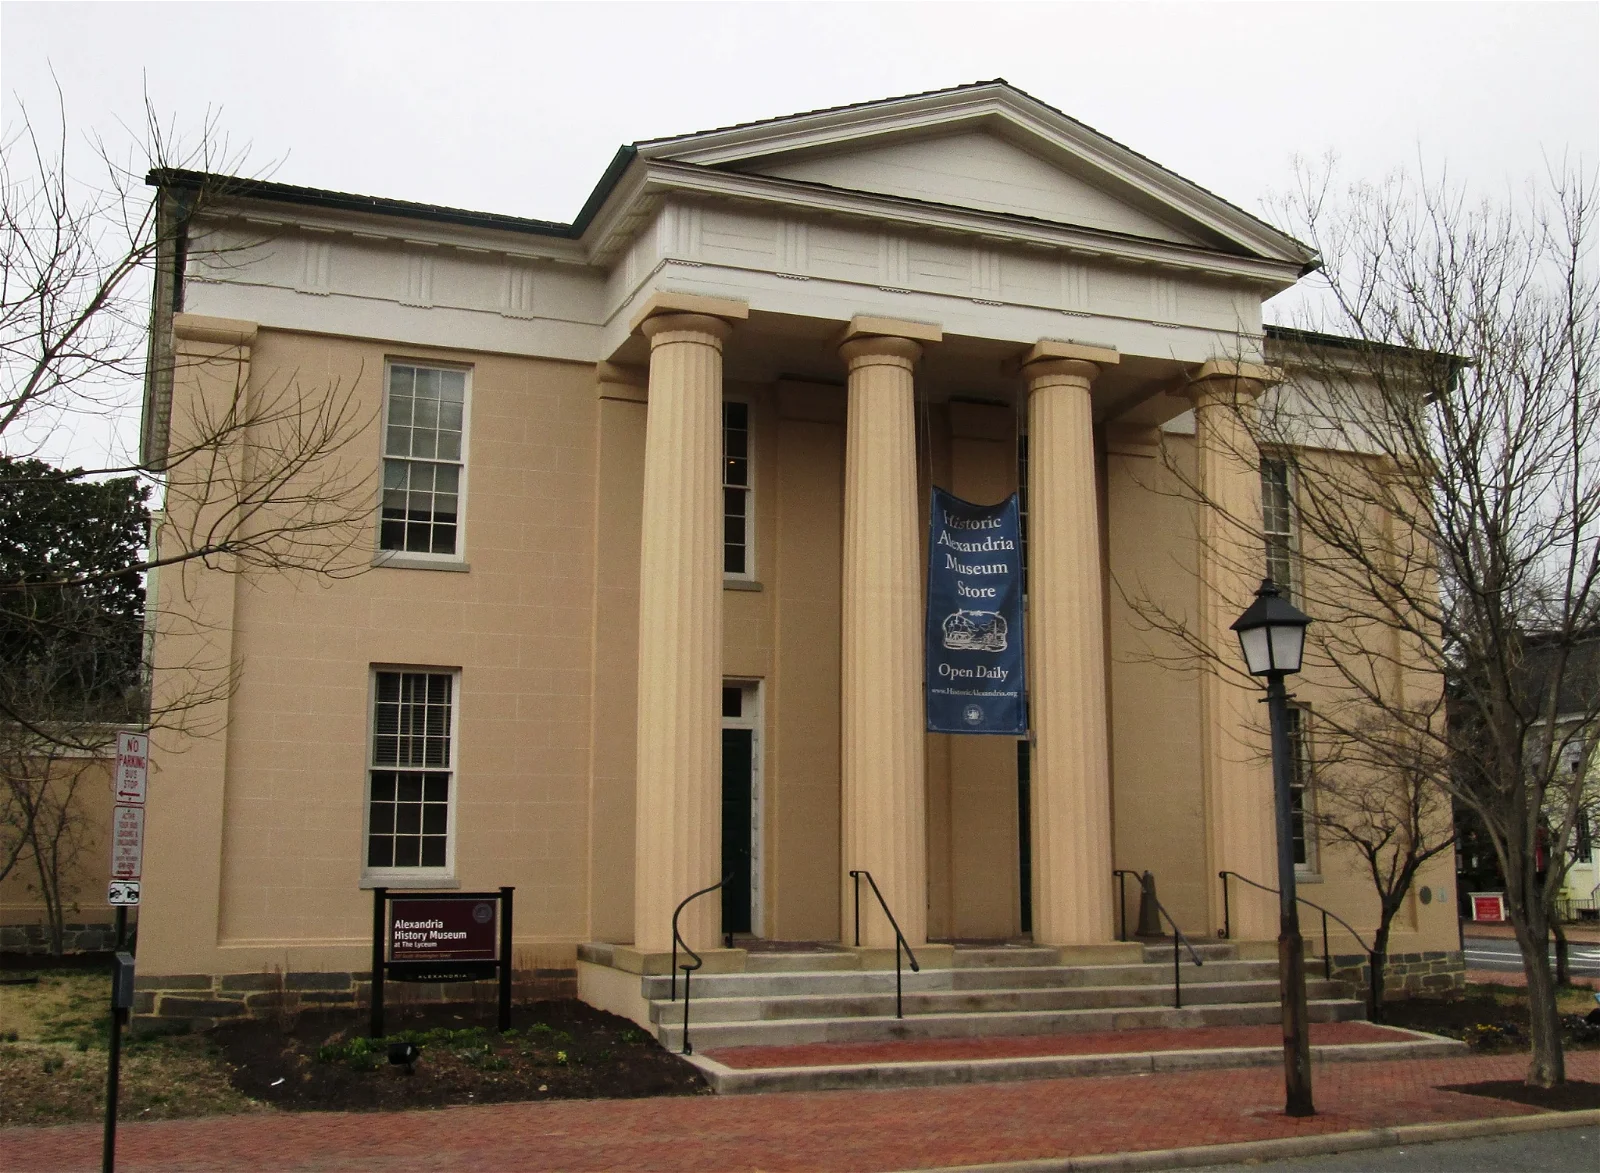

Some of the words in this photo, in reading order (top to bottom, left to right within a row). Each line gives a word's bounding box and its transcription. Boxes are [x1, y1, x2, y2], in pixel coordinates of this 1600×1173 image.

[943, 509, 1002, 530] Historic
[937, 529, 1015, 553] Alexandria
[945, 553, 1009, 575] Museum
[957, 580, 997, 598] Store
[938, 663, 973, 680] Open
[976, 665, 1009, 682] Daily
[931, 687, 1018, 698] www.HistoricAlexandria.org
[127, 739, 139, 753] NO
[119, 753, 146, 769] PARKING
[125, 769, 138, 779] BUS
[124, 779, 139, 789] STOP
[394, 919, 444, 929] Alexandria
[394, 930, 428, 941] History
[429, 930, 467, 940] Museum
[414, 941, 437, 949] Lyceum
